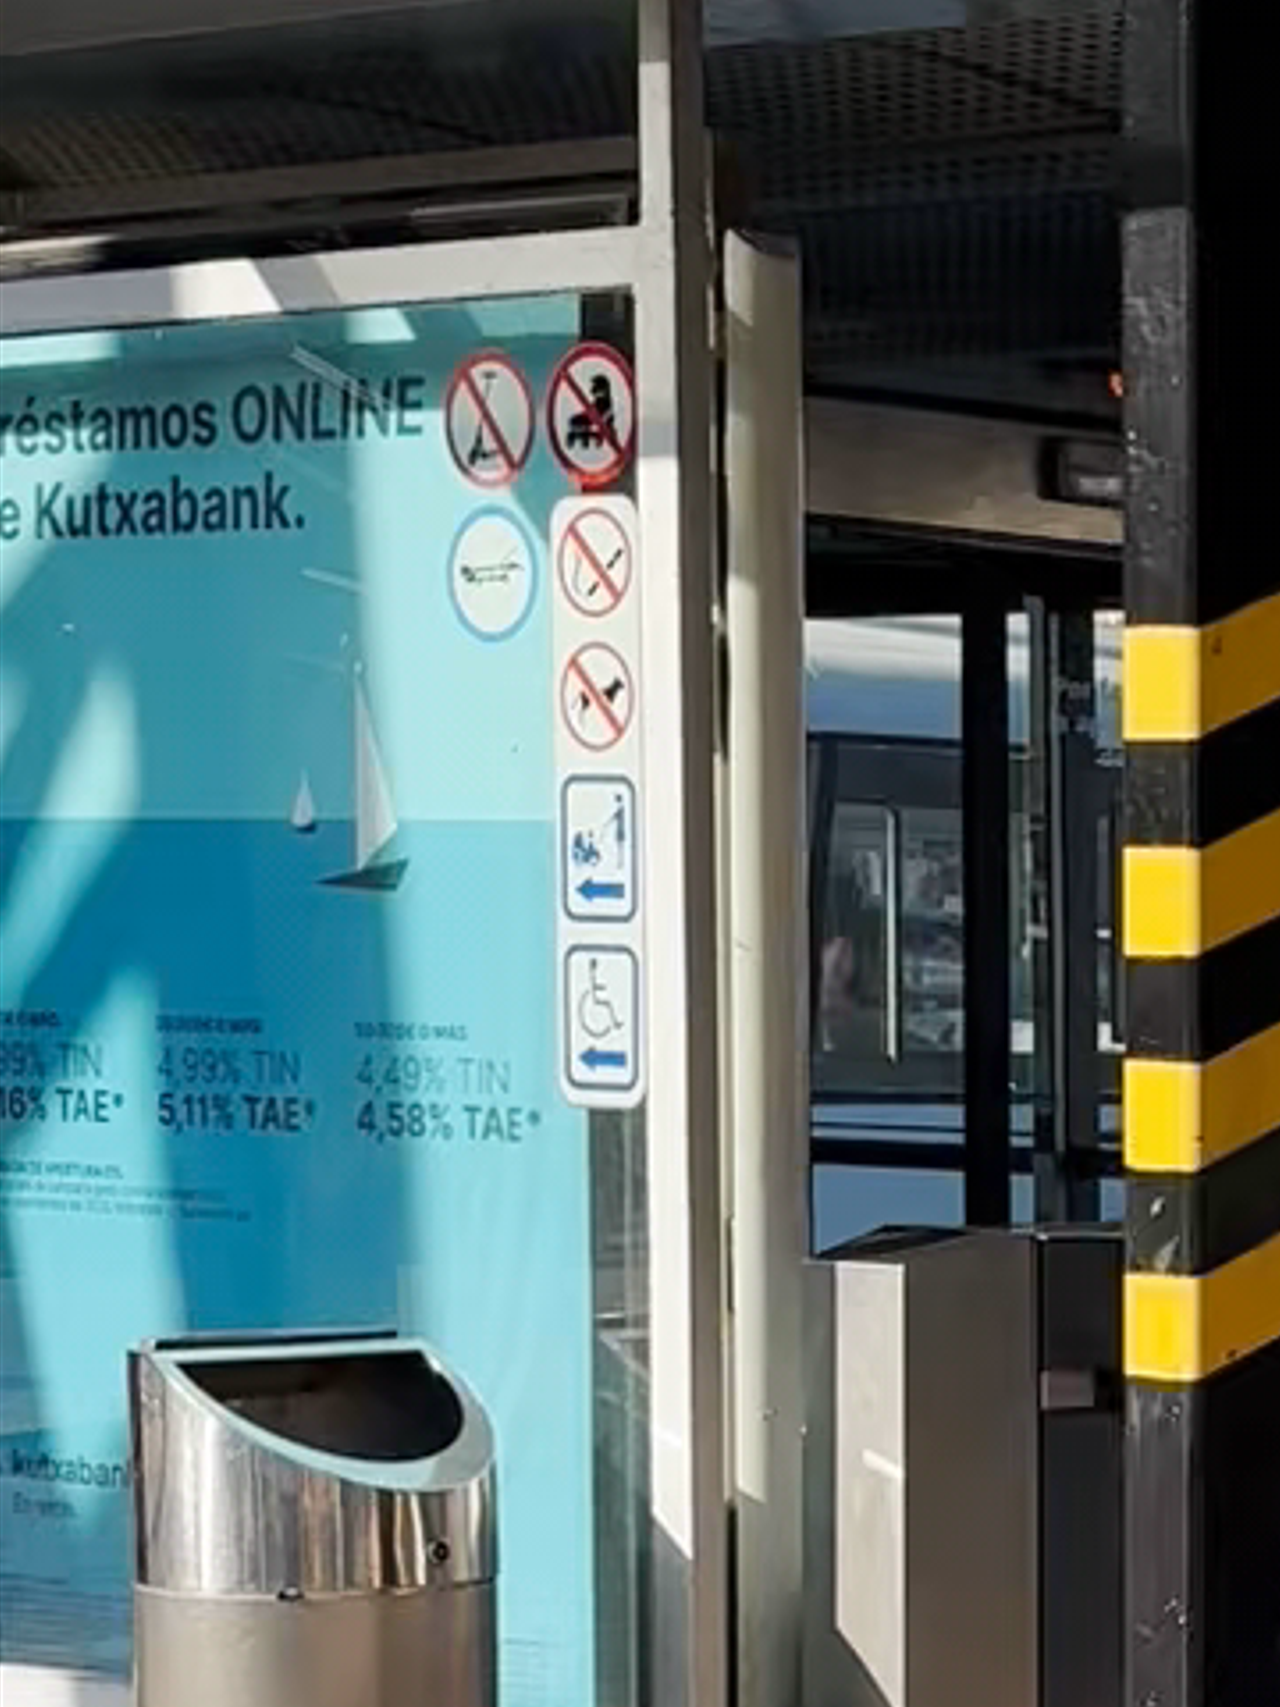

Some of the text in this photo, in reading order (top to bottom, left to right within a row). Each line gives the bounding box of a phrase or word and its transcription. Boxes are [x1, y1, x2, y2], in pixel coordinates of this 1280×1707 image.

[231, 377, 425, 445] ONLINE
[36, 471, 306, 539] Kutxabank.
[57, 1044, 102, 1079] TIN
[157, 1047, 299, 1088] 4,99% TIN
[355, 1053, 511, 1095] 4,49% TIN
[158, 1092, 234, 1135] 5,11%
[357, 1101, 455, 1145] 4,58%
